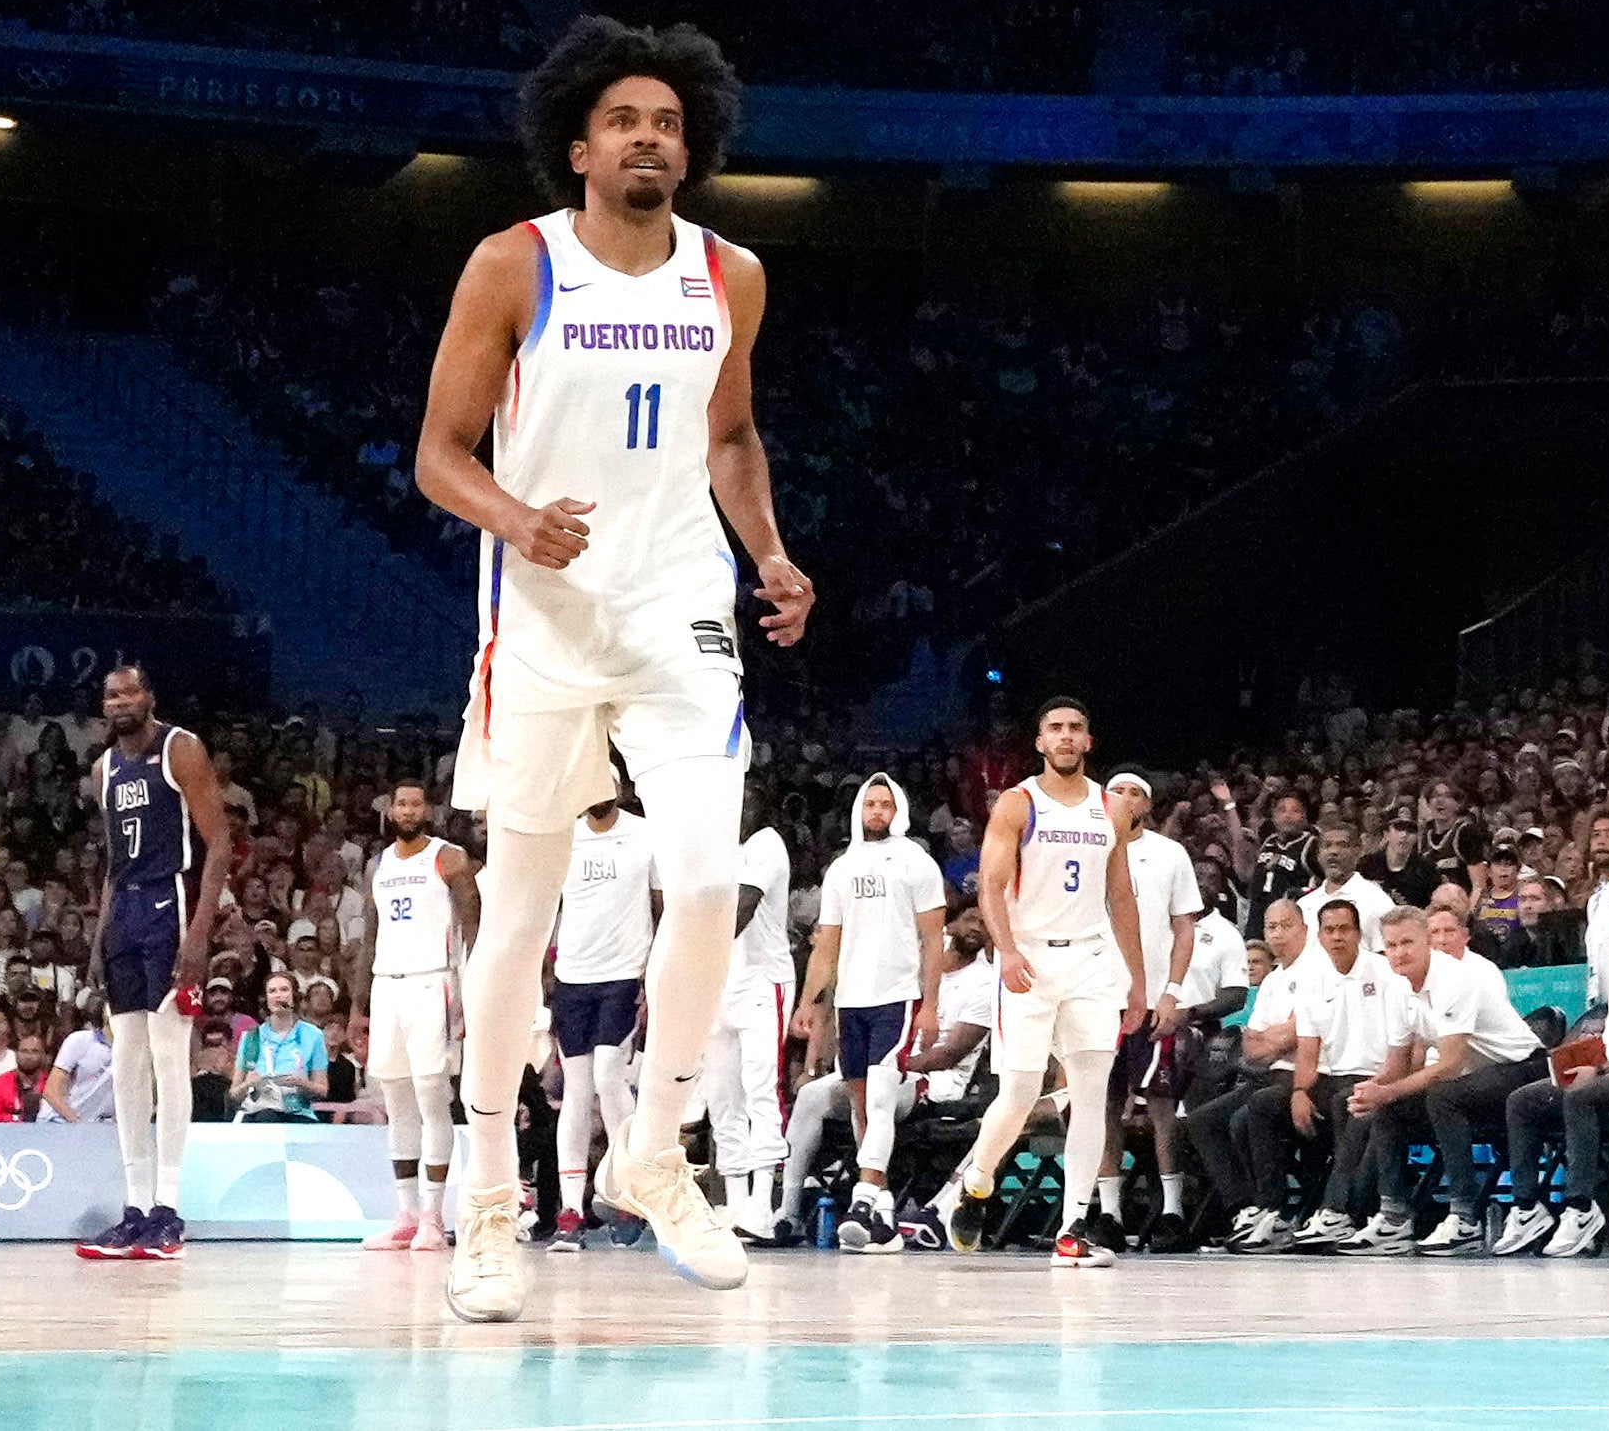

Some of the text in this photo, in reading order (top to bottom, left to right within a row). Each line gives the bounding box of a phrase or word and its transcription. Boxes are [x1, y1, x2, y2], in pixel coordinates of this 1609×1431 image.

[562, 323, 715, 352] PUERTO RICO
[625, 384, 660, 450] 11
[114, 779, 151, 812] USA
[121, 816, 142, 859] 7
[1038, 830, 1107, 847] PUERTO RICO
[582, 858, 617, 881] USA
[1064, 860, 1080, 892] 3
[852, 874, 887, 899] USA
[390, 897, 412, 921] 32
